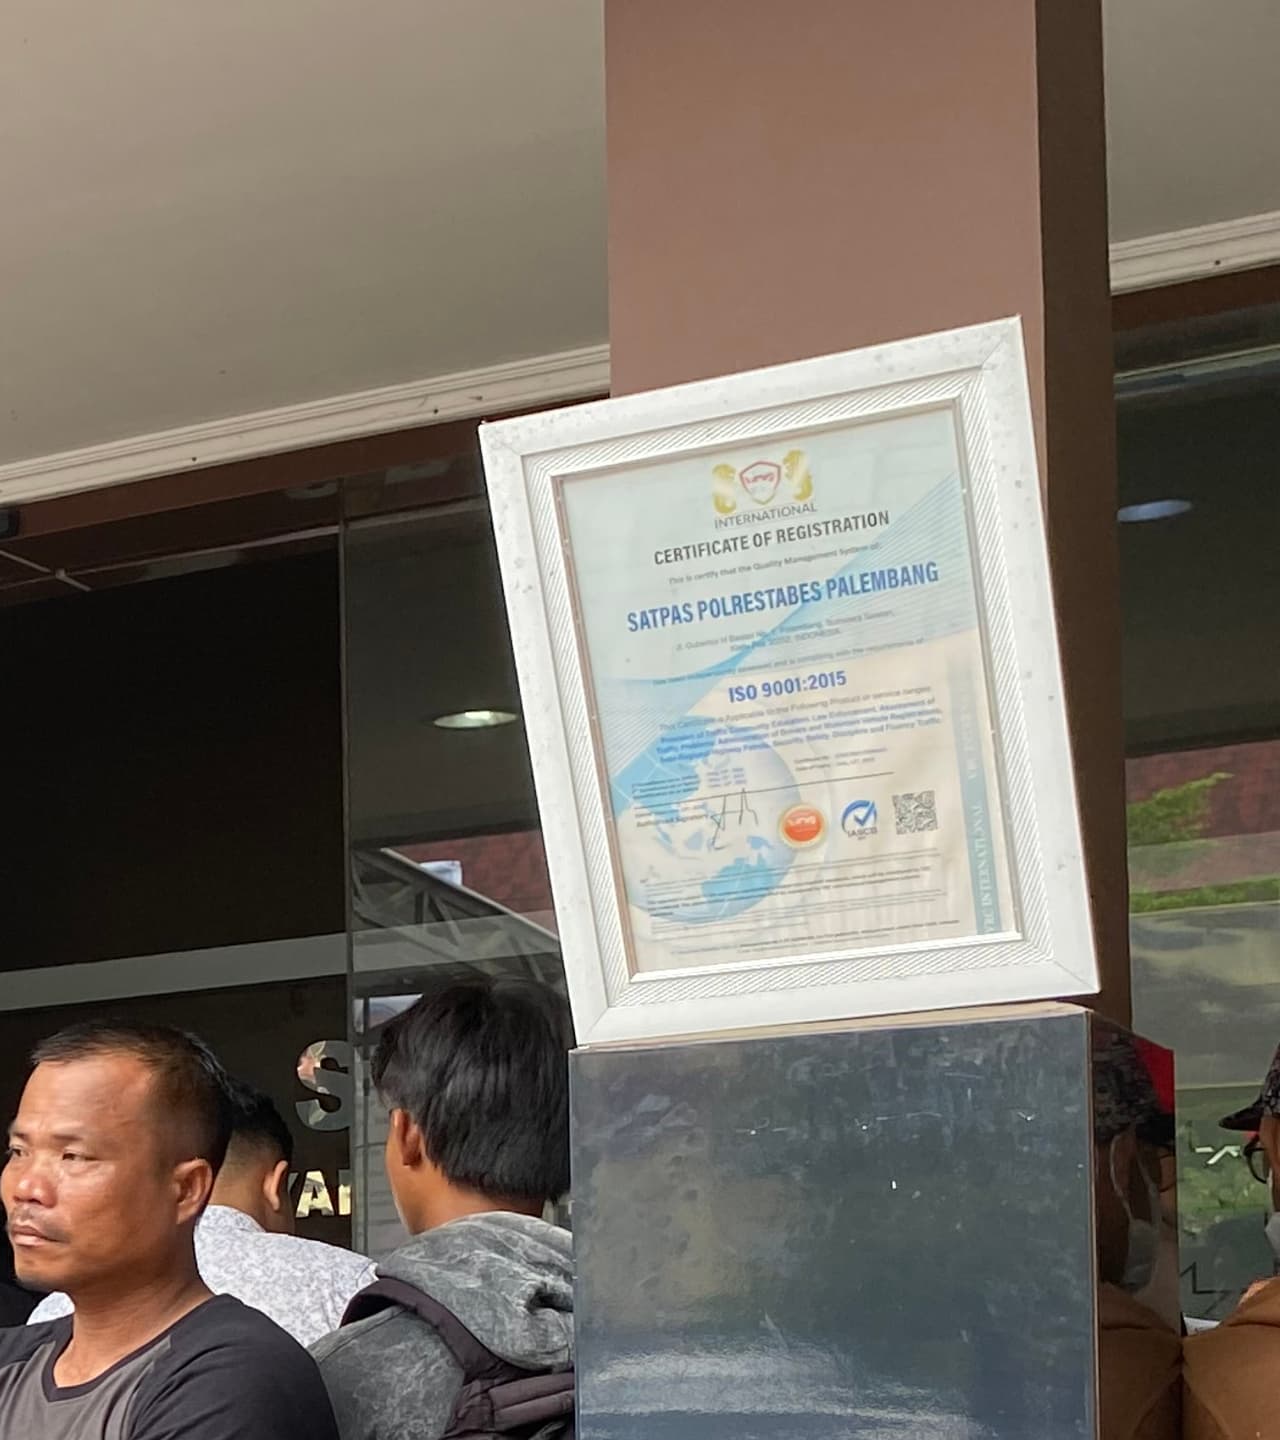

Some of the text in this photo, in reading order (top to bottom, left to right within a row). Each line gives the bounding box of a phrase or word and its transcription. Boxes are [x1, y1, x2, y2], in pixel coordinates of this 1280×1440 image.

[715, 503, 817, 528] INTERNATIONAL
[652, 511, 891, 564] CERTIFICATE OF REGISTRATION
[625, 562, 939, 631] SATPAS POLRESTABES PALEMBANG
[727, 670, 847, 703] ISO 9001:2015
